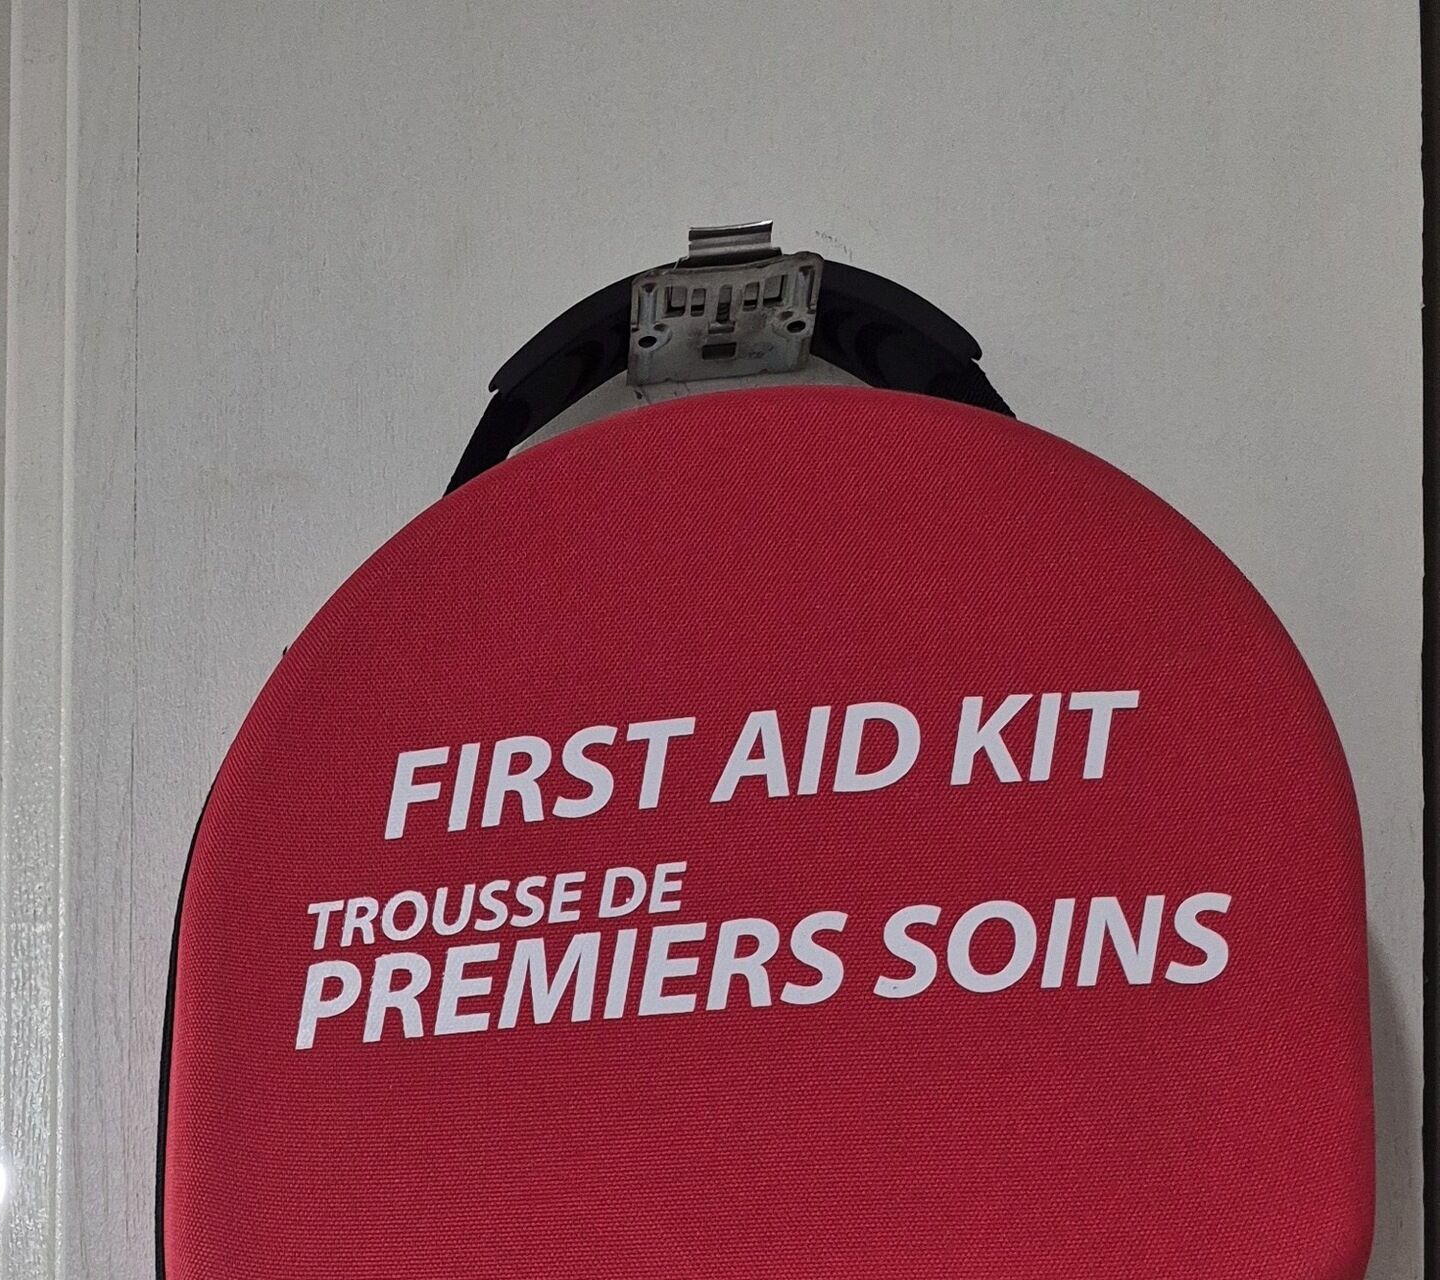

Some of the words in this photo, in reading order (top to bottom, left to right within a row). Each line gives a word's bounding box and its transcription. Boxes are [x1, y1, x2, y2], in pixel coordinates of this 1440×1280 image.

[384, 717, 694, 840] FIRST
[710, 701, 921, 804] AID
[950, 690, 1140, 787] KIT
[294, 910, 848, 1050] PREMIERS
[872, 892, 1232, 999] SOINS
[307, 869, 589, 949] TROUSSE
[599, 862, 687, 918] DE
